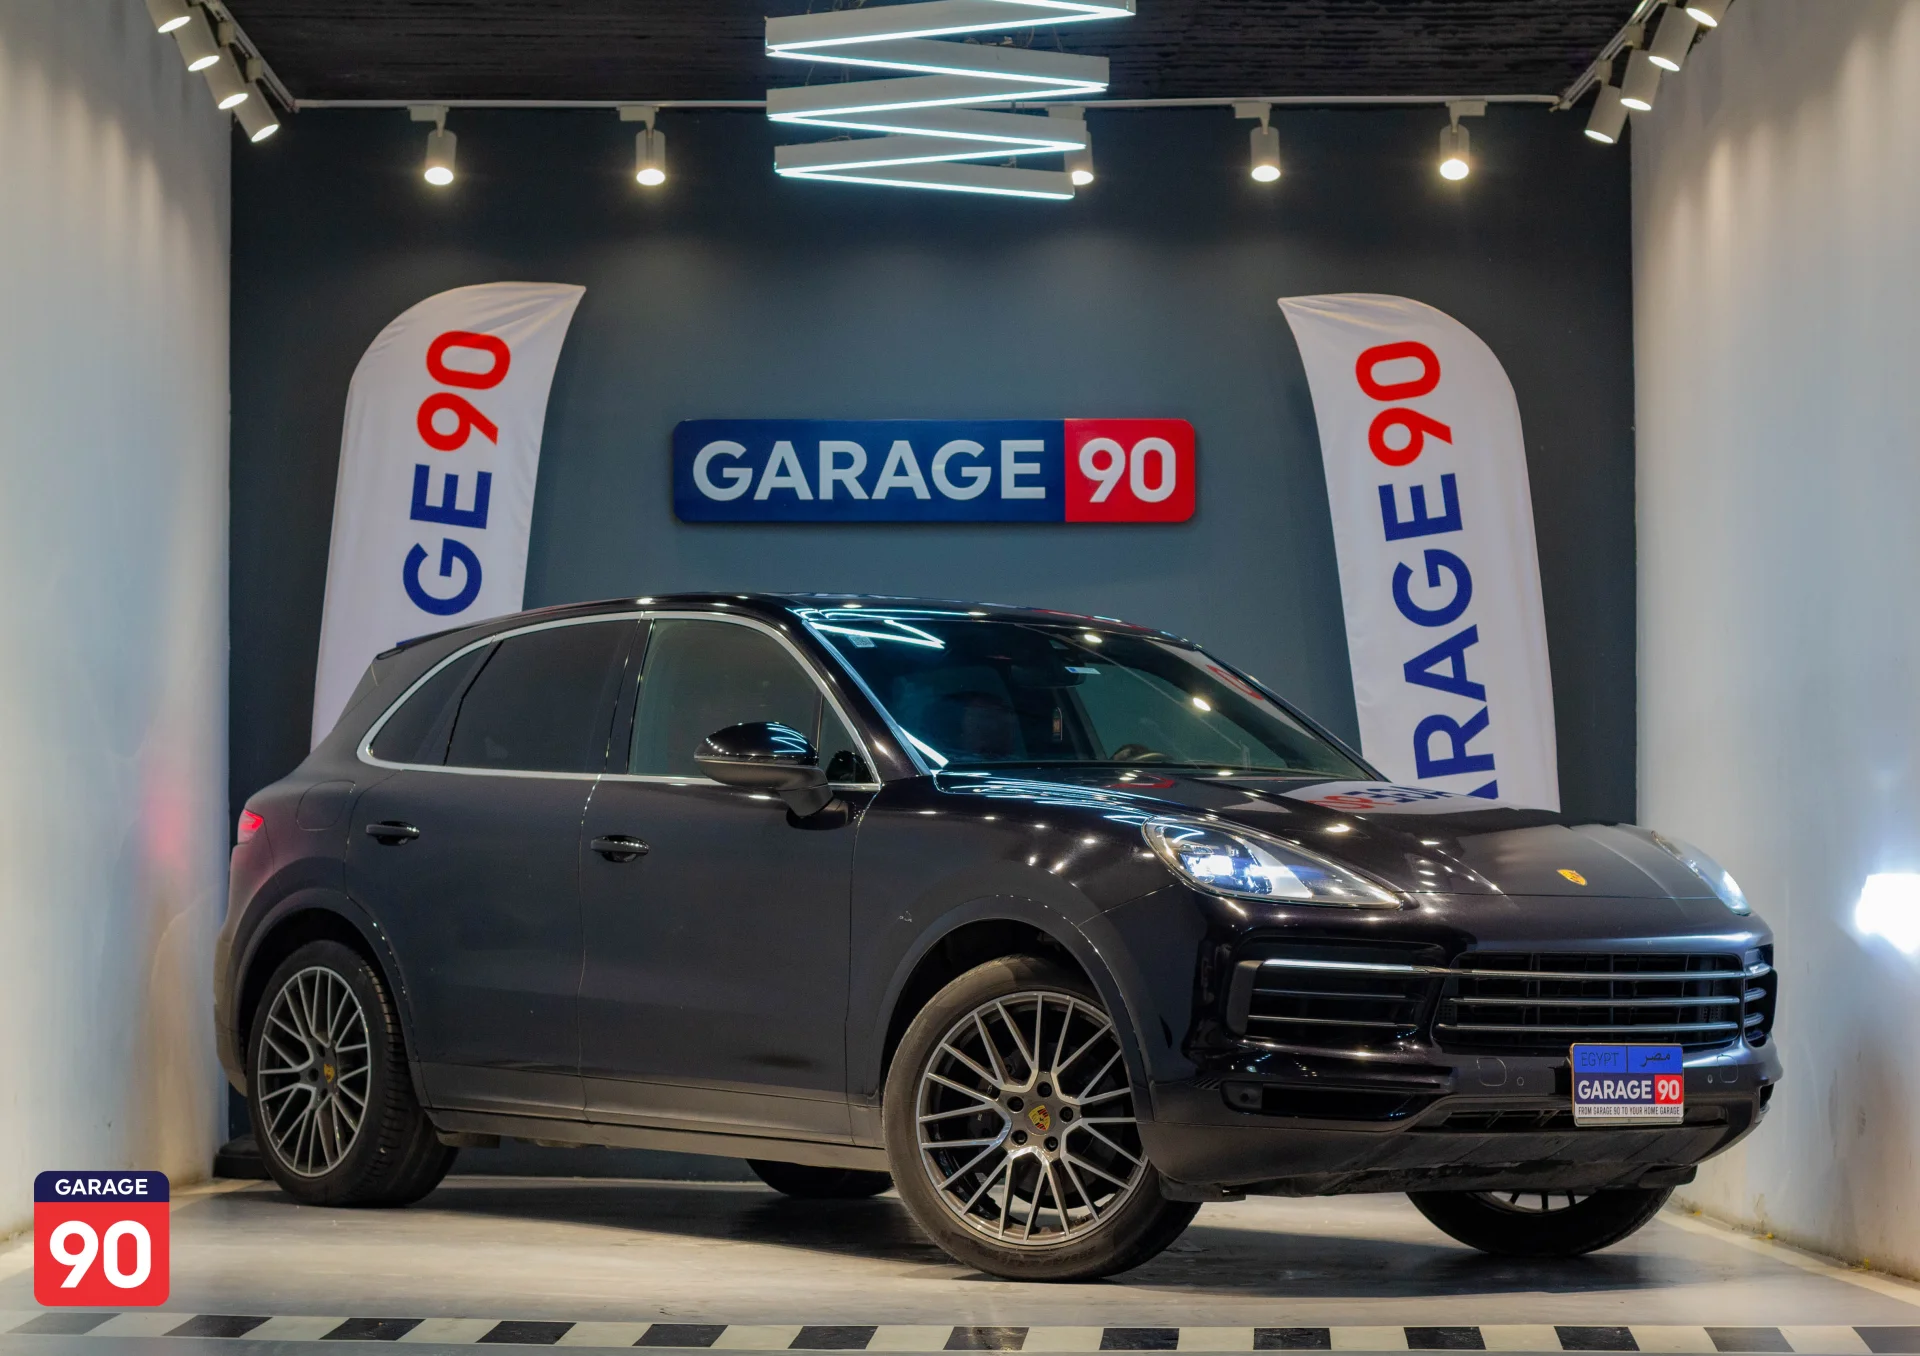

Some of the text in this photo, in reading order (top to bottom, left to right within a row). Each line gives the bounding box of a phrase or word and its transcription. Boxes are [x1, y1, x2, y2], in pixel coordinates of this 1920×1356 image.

[693, 437, 1177, 503] GARAGE 90
[1580, 1052, 1619, 1067] EGYPT
[1640, 1052, 1671, 1068] مصر
[1578, 1079, 1680, 1100] GARAGE 90
[1578, 1106, 1680, 1115] FROM GARAGE 90 TO YOUR HOME GARAGE
